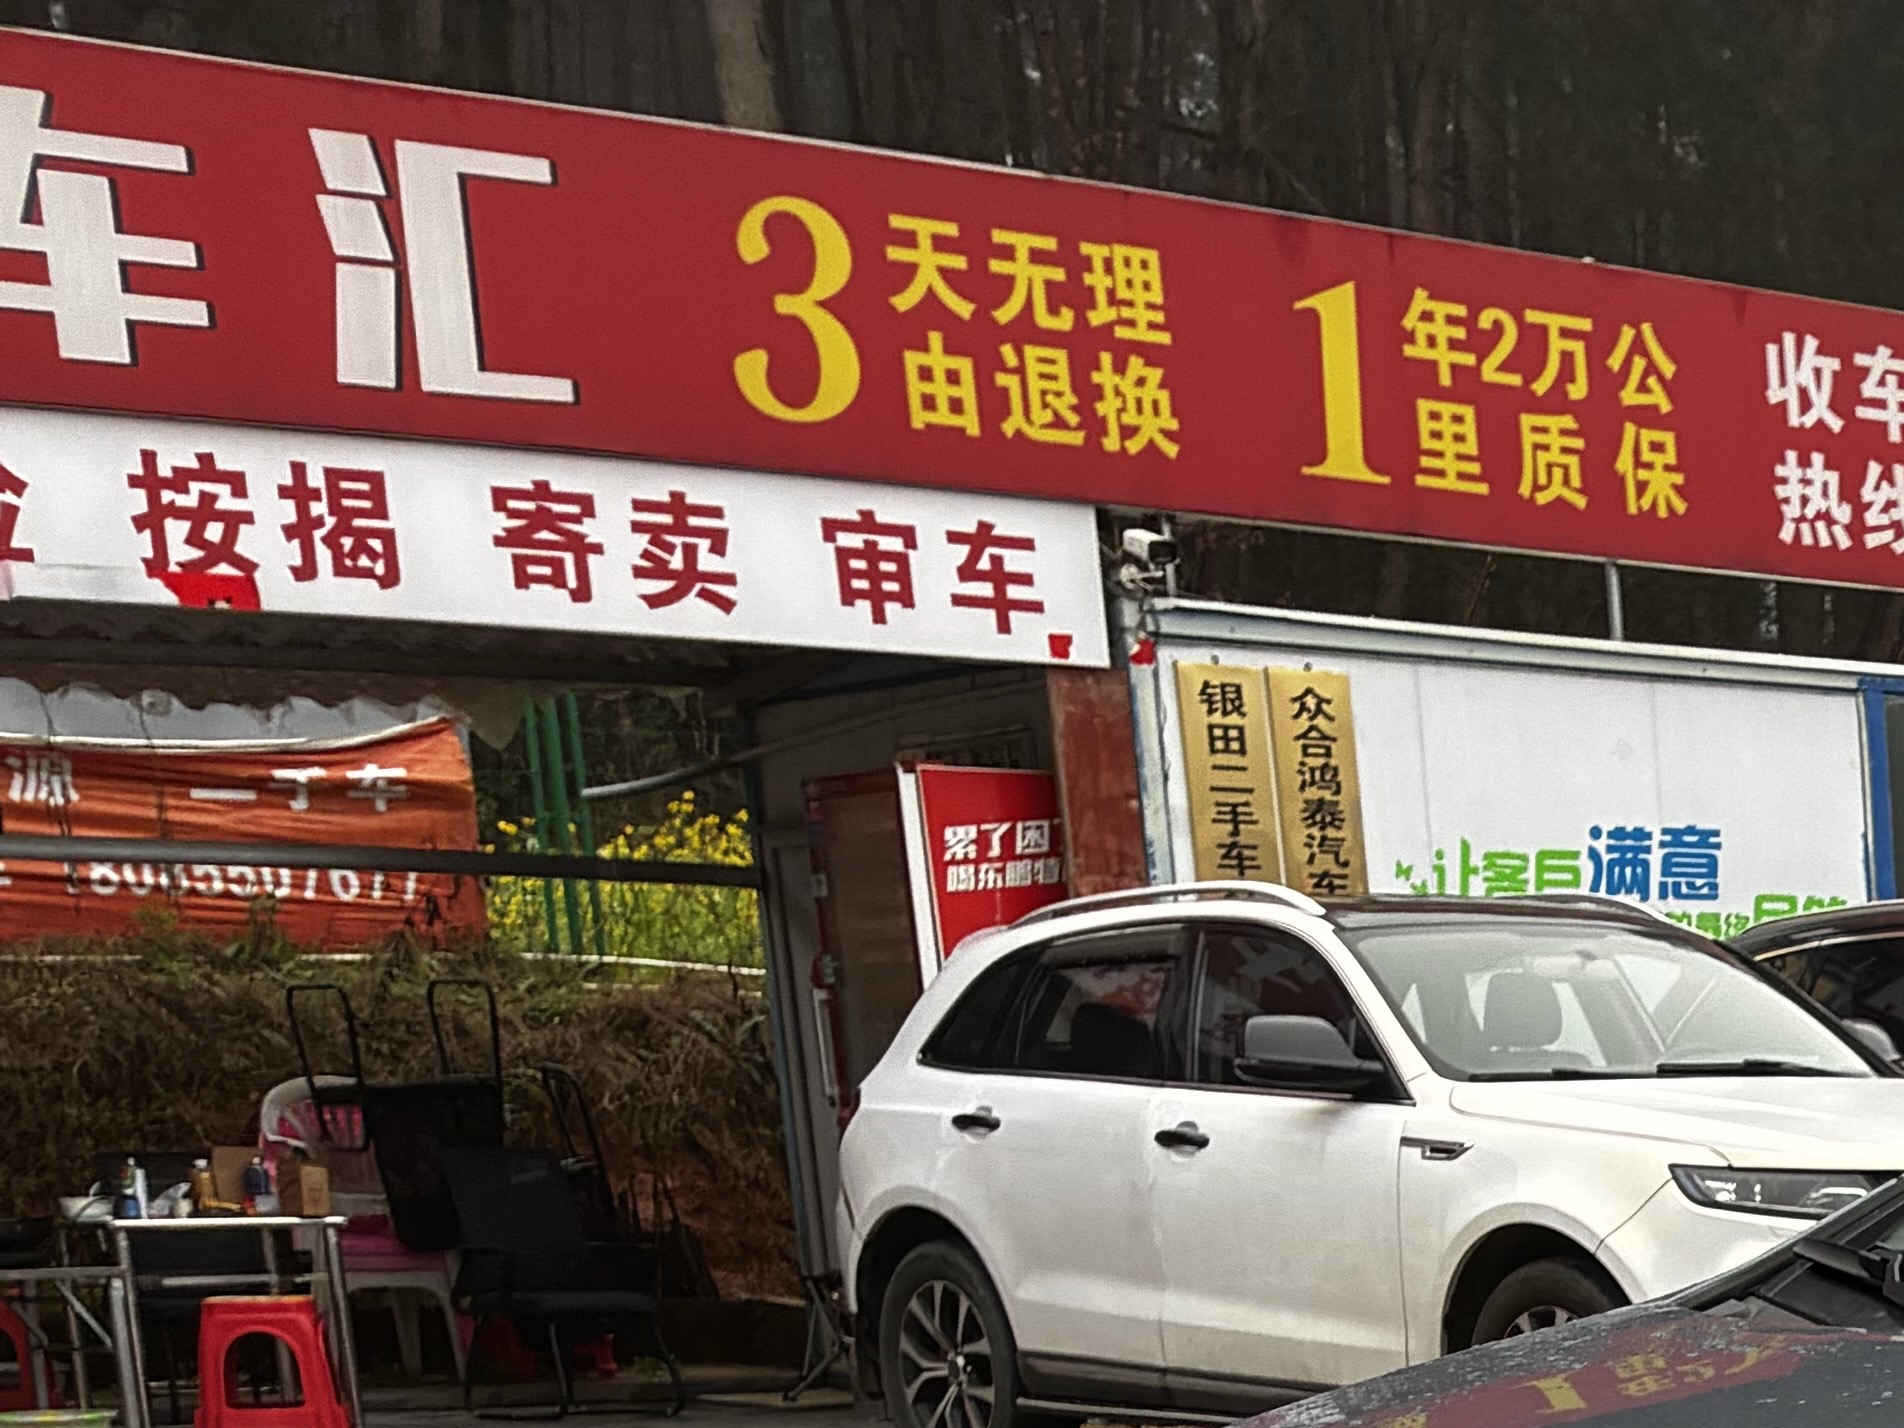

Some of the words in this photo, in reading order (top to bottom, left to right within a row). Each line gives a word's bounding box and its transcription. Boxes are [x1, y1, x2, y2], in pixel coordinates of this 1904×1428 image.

[734, 196, 861, 423] 3
[886, 214, 1173, 346] 天无理
[904, 334, 1181, 460] 由退换
[1294, 281, 1391, 484] 1
[1402, 287, 1677, 415] 年2万公
[127, 449, 401, 589] 按揭
[490, 479, 738, 614] 寄卖
[821, 509, 1045, 634] 审车
[1414, 398, 1688, 519] 里质保
[943, 818, 1062, 862] 累了困
[1198, 680, 1262, 878] 银田二手车
[1291, 687, 1351, 895] 众合鸿泰汽车
[947, 857, 1067, 893] 喝东鹏特
